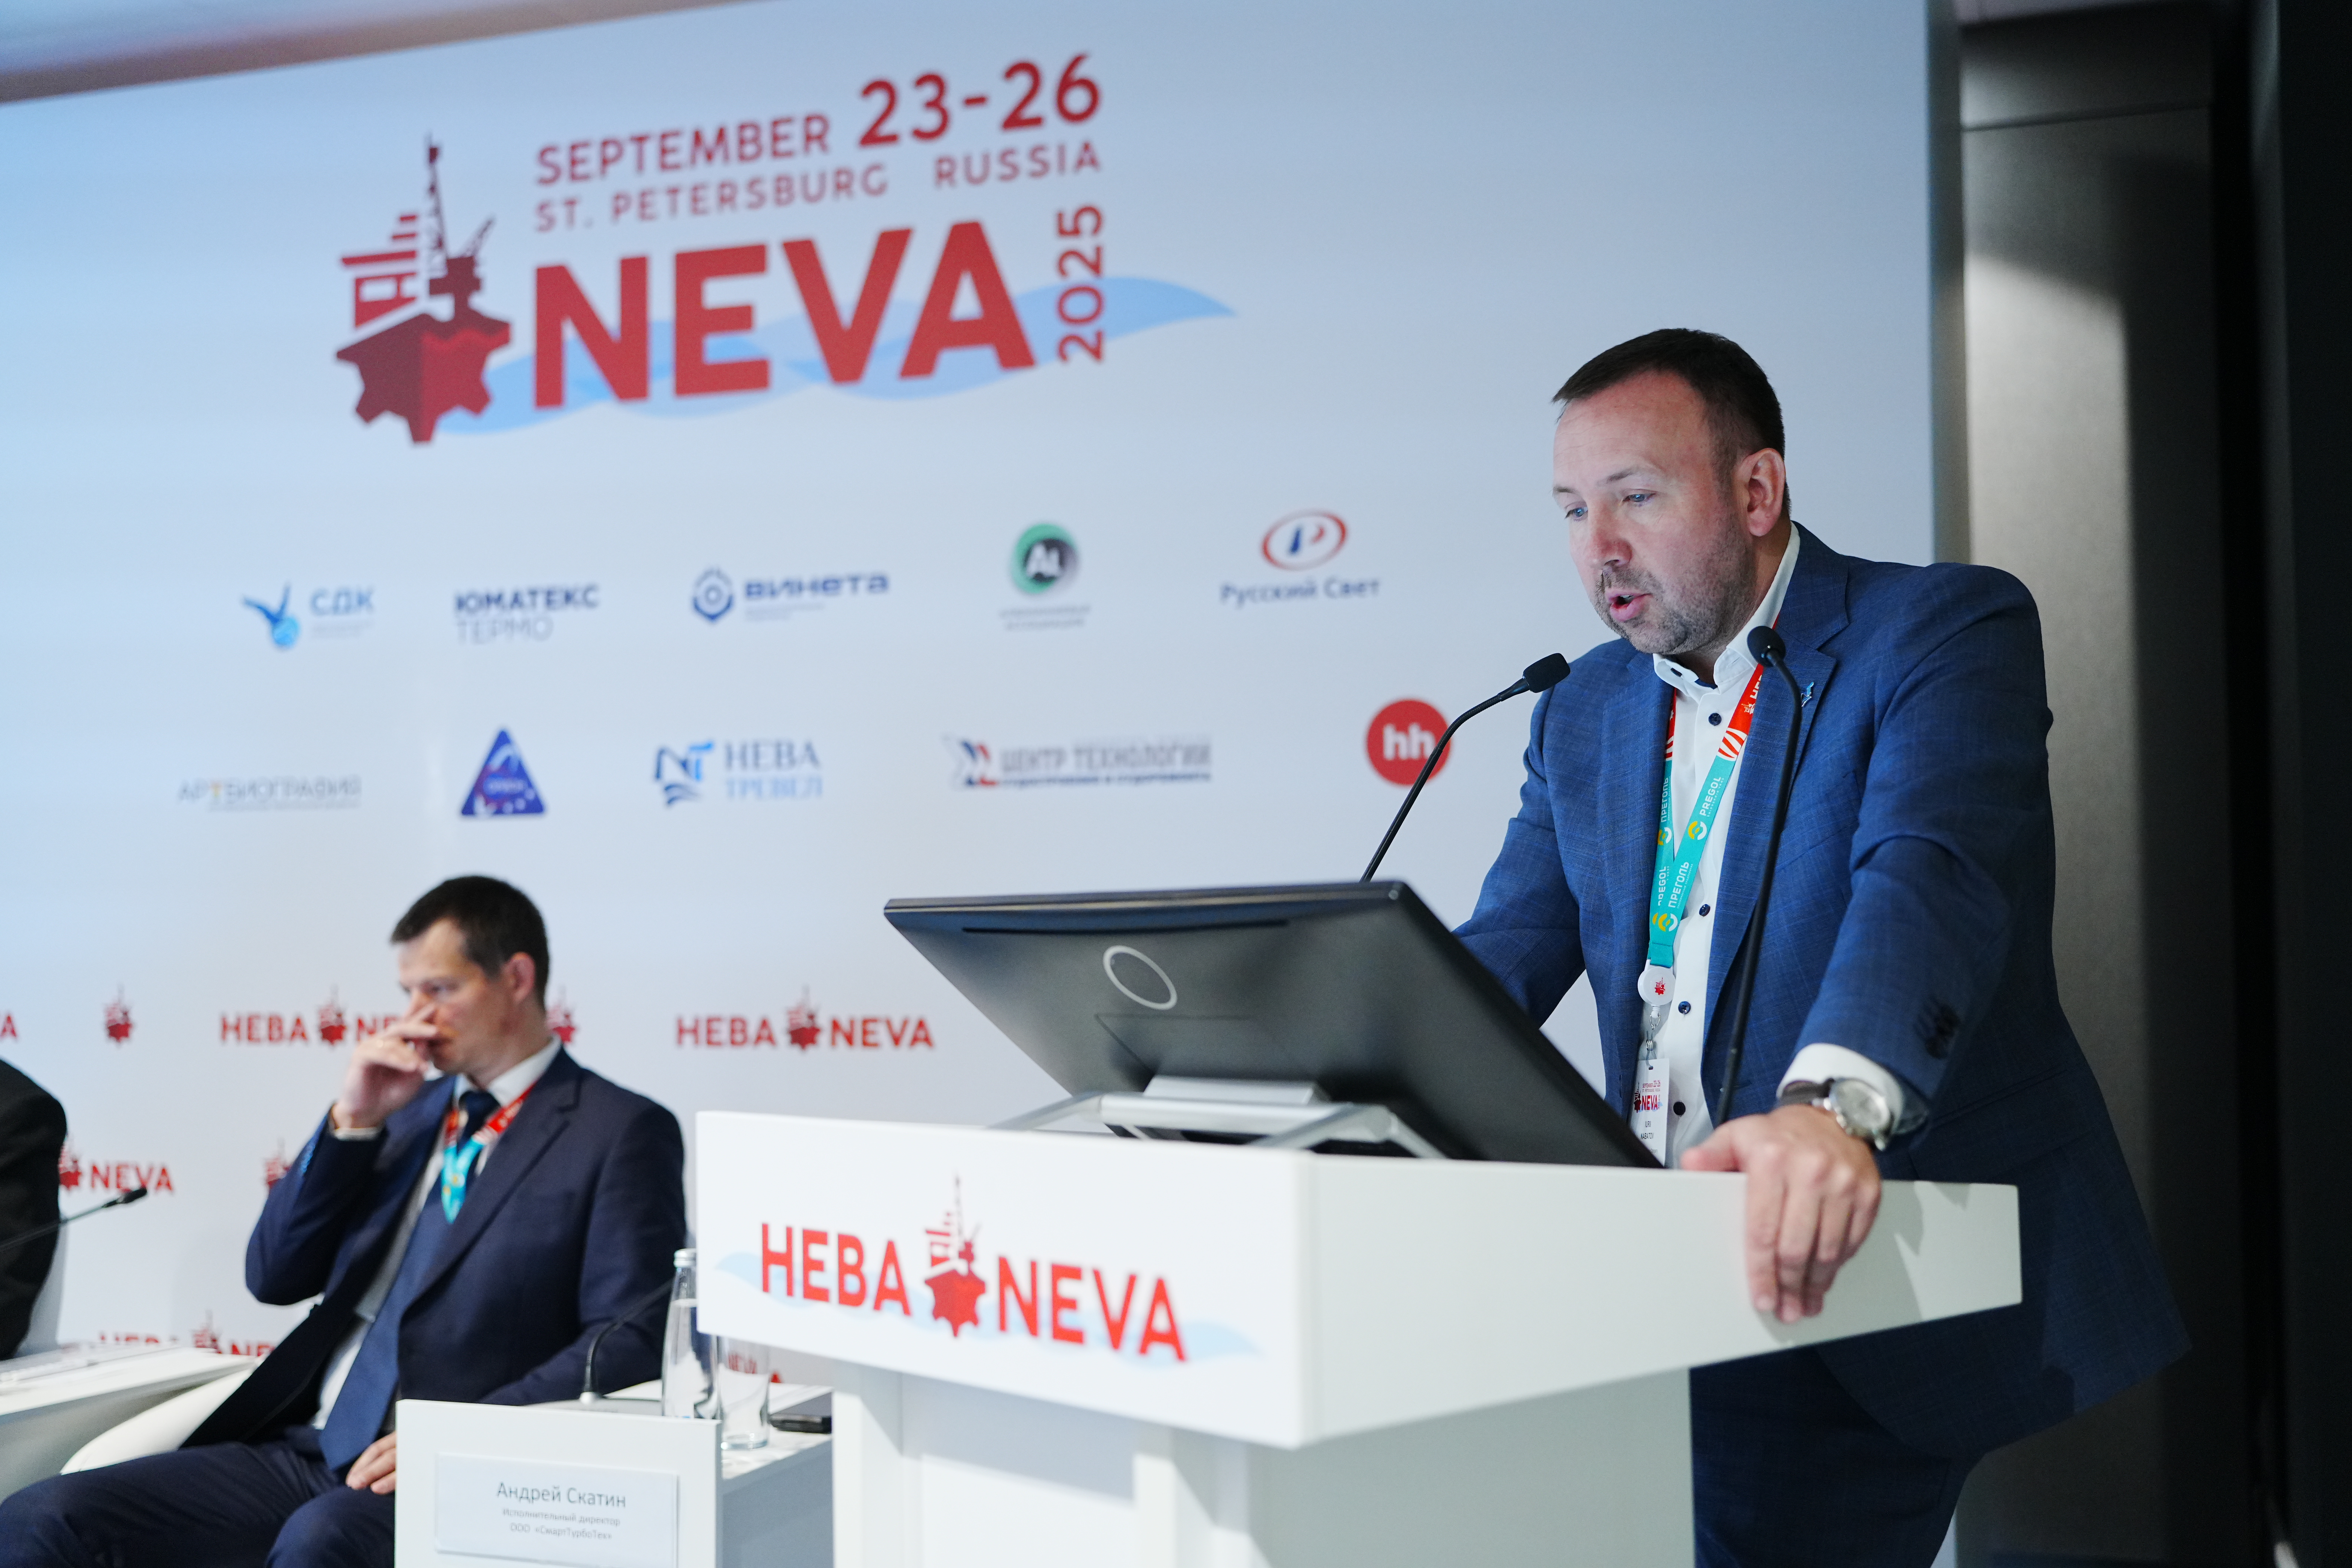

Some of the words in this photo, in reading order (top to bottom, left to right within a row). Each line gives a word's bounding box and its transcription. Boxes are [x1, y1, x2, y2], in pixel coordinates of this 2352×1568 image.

[536, 113, 831, 185] SEPTEMBER
[858, 54, 1101, 147] 23-26
[535, 195, 596, 232] ST.
[612, 164, 888, 227] PETERSBURG
[934, 141, 1101, 189] RUSSIA
[1056, 204, 1105, 363] 2025
[534, 220, 1037, 411] NEVA
[309, 587, 373, 616] СДК
[455, 584, 599, 614] ЮМАТЕКС
[1220, 578, 1317, 608] Русский
[1323, 574, 1380, 599] Свет
[455, 614, 553, 643] ТЕРМО
[724, 740, 820, 770] НЕВА
[1383, 721, 1436, 761] hh
[1699, 777, 1721, 816] PREGOL
[1668, 862, 1690, 908] ПРЕГОЛЬ
[830, 1017, 934, 1049] NEVA
[1642, 1095, 1658, 1111] NEVA
[92, 1164, 174, 1193] NEVA
[998, 1256, 1188, 1361] NEVA
[497, 1481, 561, 1504] Андрей
[567, 1487, 626, 1508] Скатин
[502, 1508, 577, 1522] Исполнительный
[579, 1515, 621, 1527] директор
[510, 1522, 531, 1534] ООО
